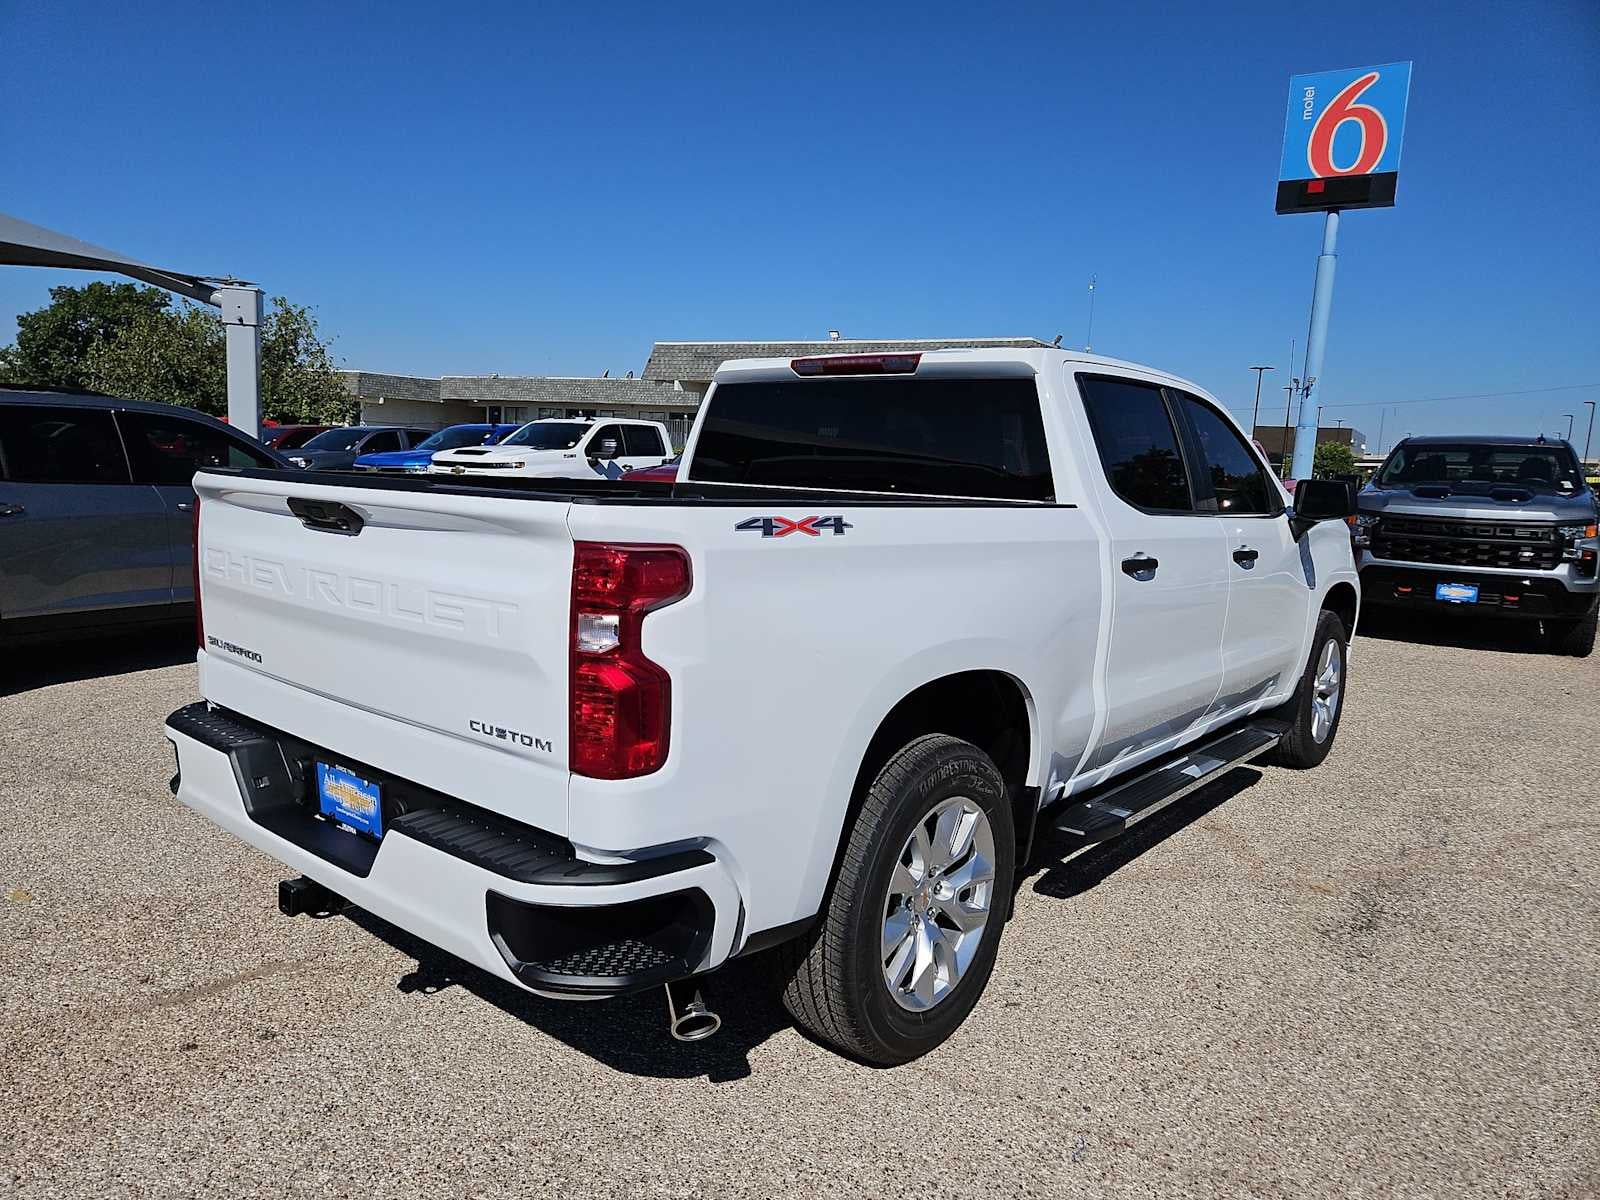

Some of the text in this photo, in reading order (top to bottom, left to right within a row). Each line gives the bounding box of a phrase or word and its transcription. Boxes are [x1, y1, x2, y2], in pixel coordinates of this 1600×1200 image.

[1303, 86, 1316, 120] motel
[1307, 72, 1388, 177] 6
[205, 547, 518, 637] CHEVROLET
[207, 635, 263, 664] SILVERADO
[469, 719, 552, 753] CUSTOM
